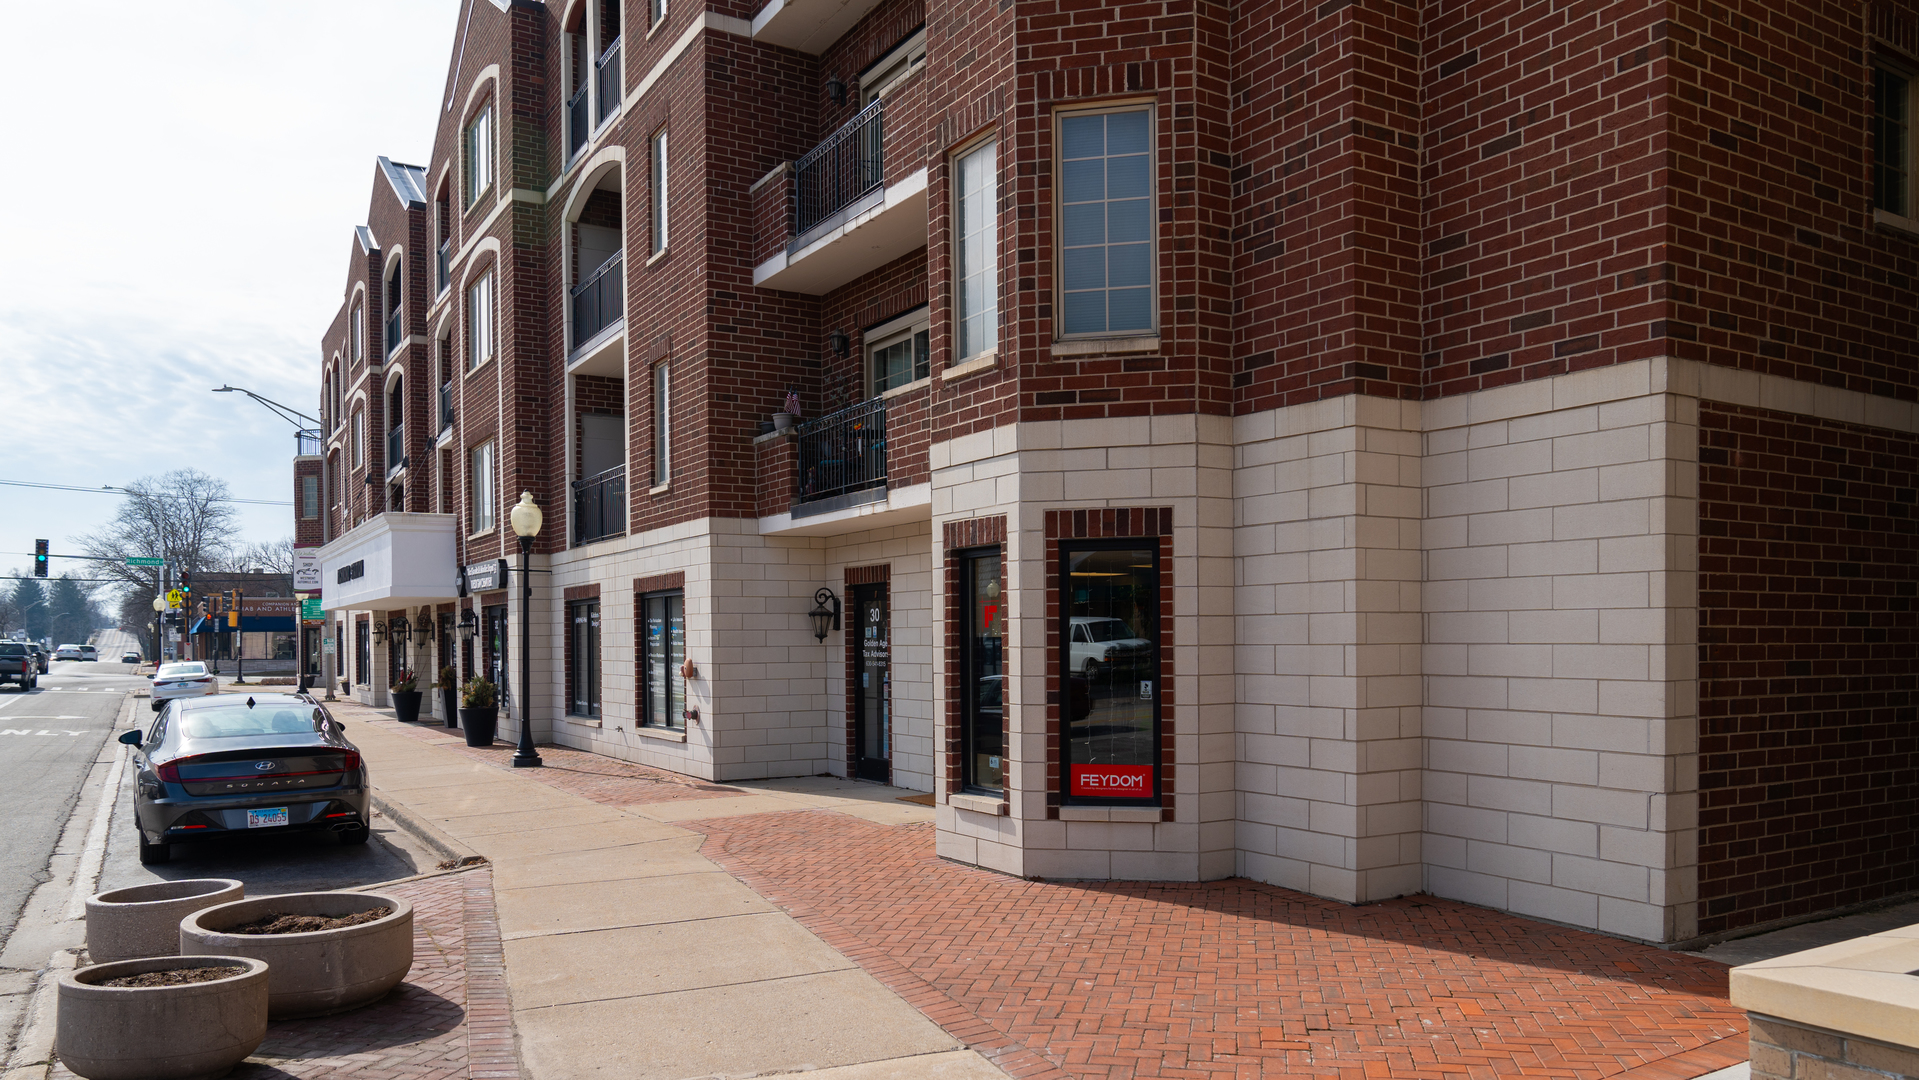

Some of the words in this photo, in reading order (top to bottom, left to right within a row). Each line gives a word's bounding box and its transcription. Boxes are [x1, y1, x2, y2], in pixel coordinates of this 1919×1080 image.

[870, 608, 880, 622] 30
[864, 639, 879, 647] Golden
[879, 639, 888, 649] Age
[226, 779, 305, 789] SONATA
[1080, 774, 1143, 787] FEYDOM
[263, 812, 287, 823] 24055
